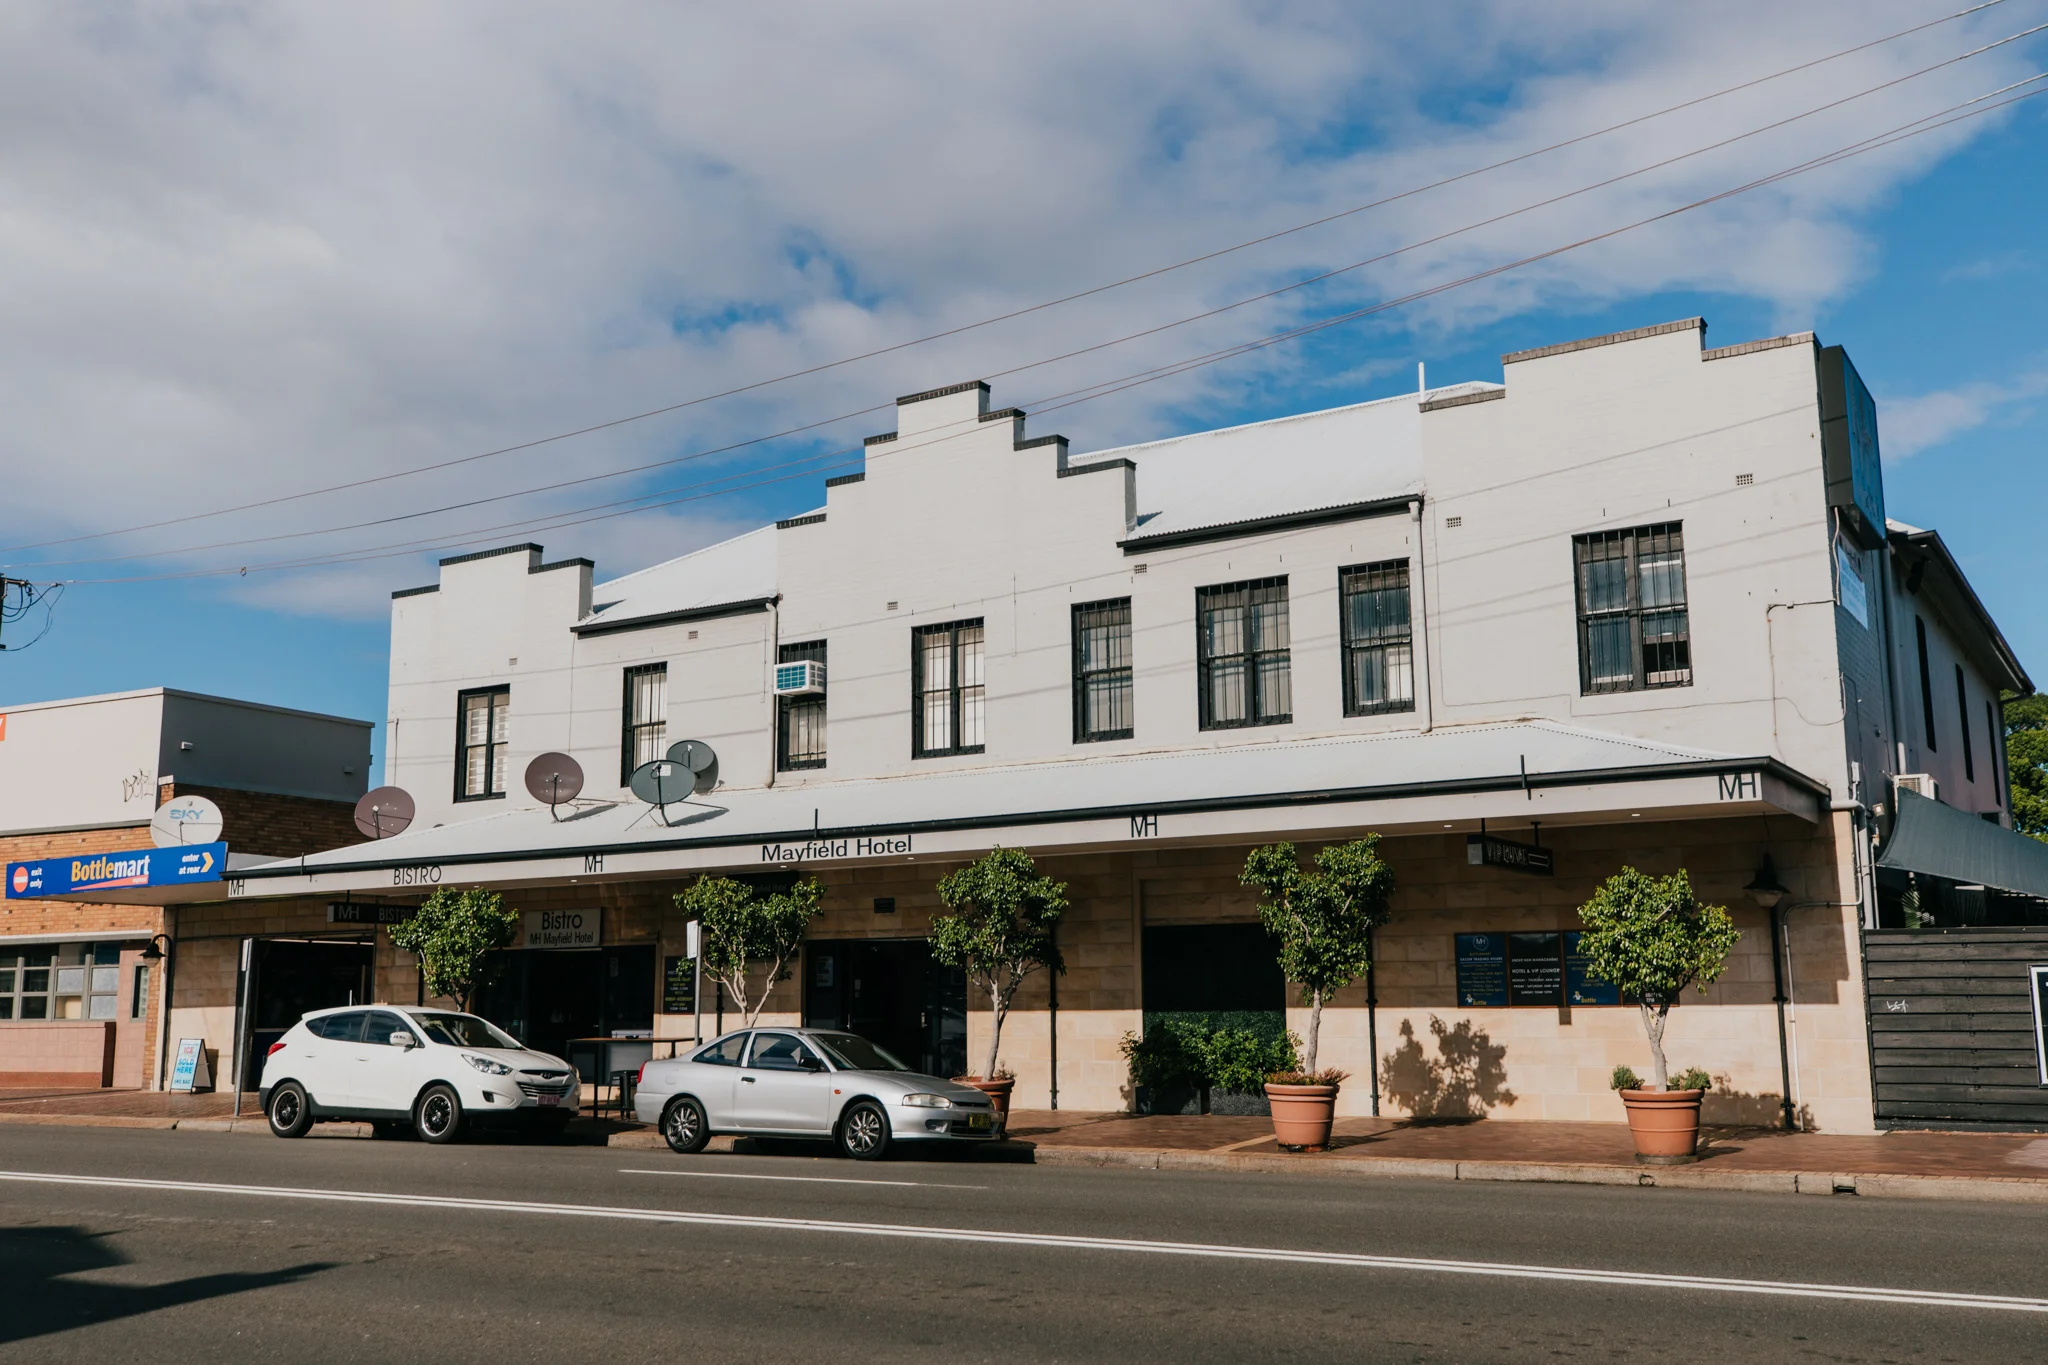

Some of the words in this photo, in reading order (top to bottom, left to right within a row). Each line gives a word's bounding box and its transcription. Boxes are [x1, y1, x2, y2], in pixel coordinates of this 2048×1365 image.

[1719, 772, 1757, 800] MH
[170, 809, 204, 820] SKY
[1131, 814, 1157, 838] MH
[761, 840, 848, 862] Mayfield
[857, 835, 912, 855] Hotel
[1485, 841, 1502, 862] VIP
[182, 854, 200, 862] enter
[585, 853, 604, 873] MH
[31, 867, 43, 876] exit
[71, 855, 150, 882] Bottlemart
[178, 866, 186, 875] at
[187, 866, 201, 874] rear
[393, 865, 442, 885] BISTRO
[30, 878, 43, 888] only
[230, 879, 246, 896] MH
[338, 905, 360, 920] MH
[379, 907, 413, 922] BISTRO
[542, 910, 583, 930] Bistro
[530, 933, 542, 945] MH
[544, 932, 573, 947] Mayfield
[575, 931, 594, 943] Hotel
[184, 1046, 194, 1054] ICE
[178, 1058, 194, 1066] SOLD
[176, 1066, 193, 1074] HERE
